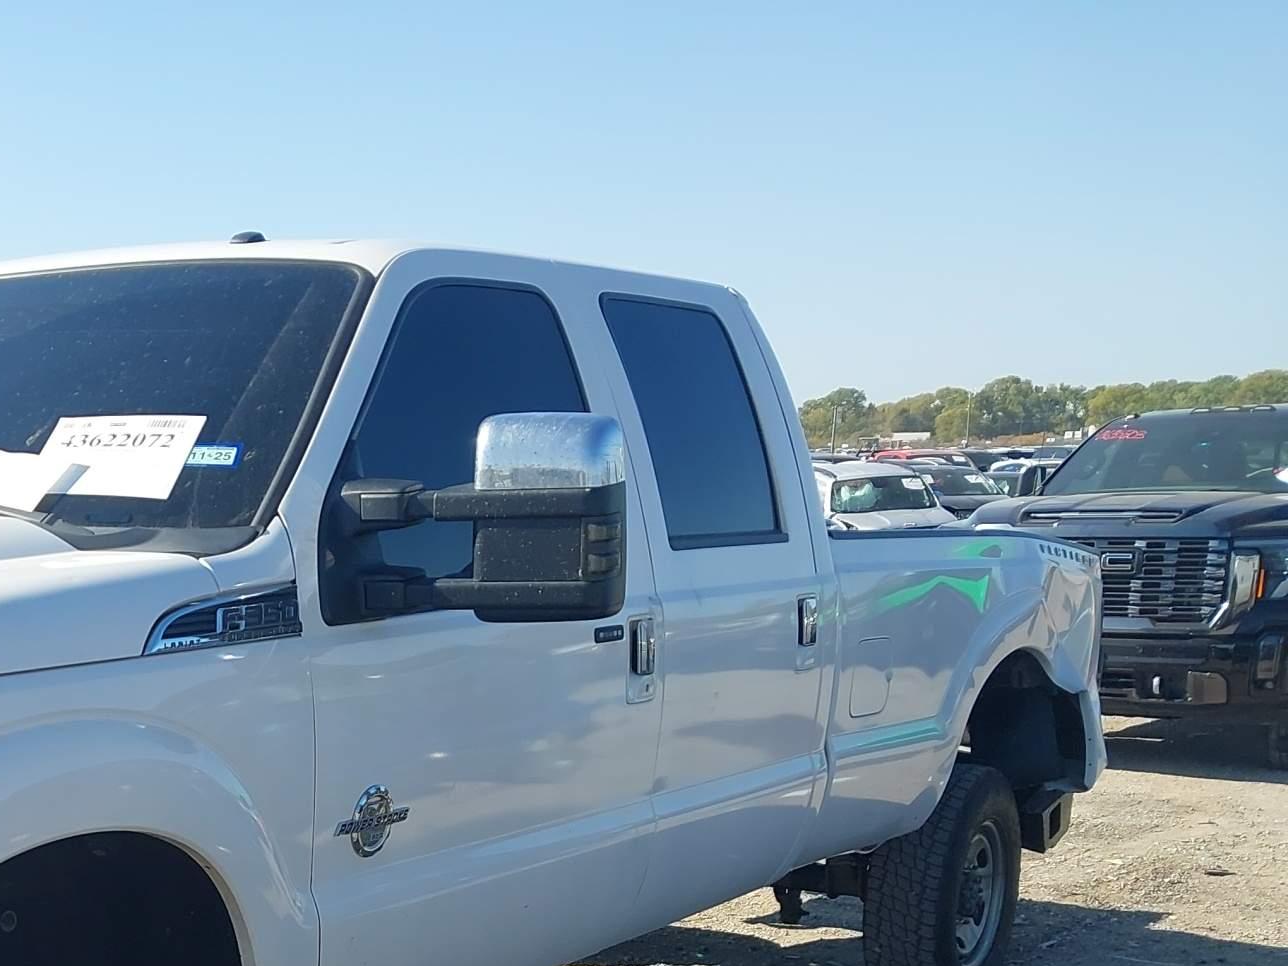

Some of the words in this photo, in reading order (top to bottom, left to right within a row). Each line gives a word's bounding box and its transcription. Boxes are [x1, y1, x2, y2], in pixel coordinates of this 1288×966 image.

[61, 432, 176, 448] 43622072
[191, 451, 206, 461] 11
[213, 451, 233, 461] 25
[338, 818, 374, 835] POWER
